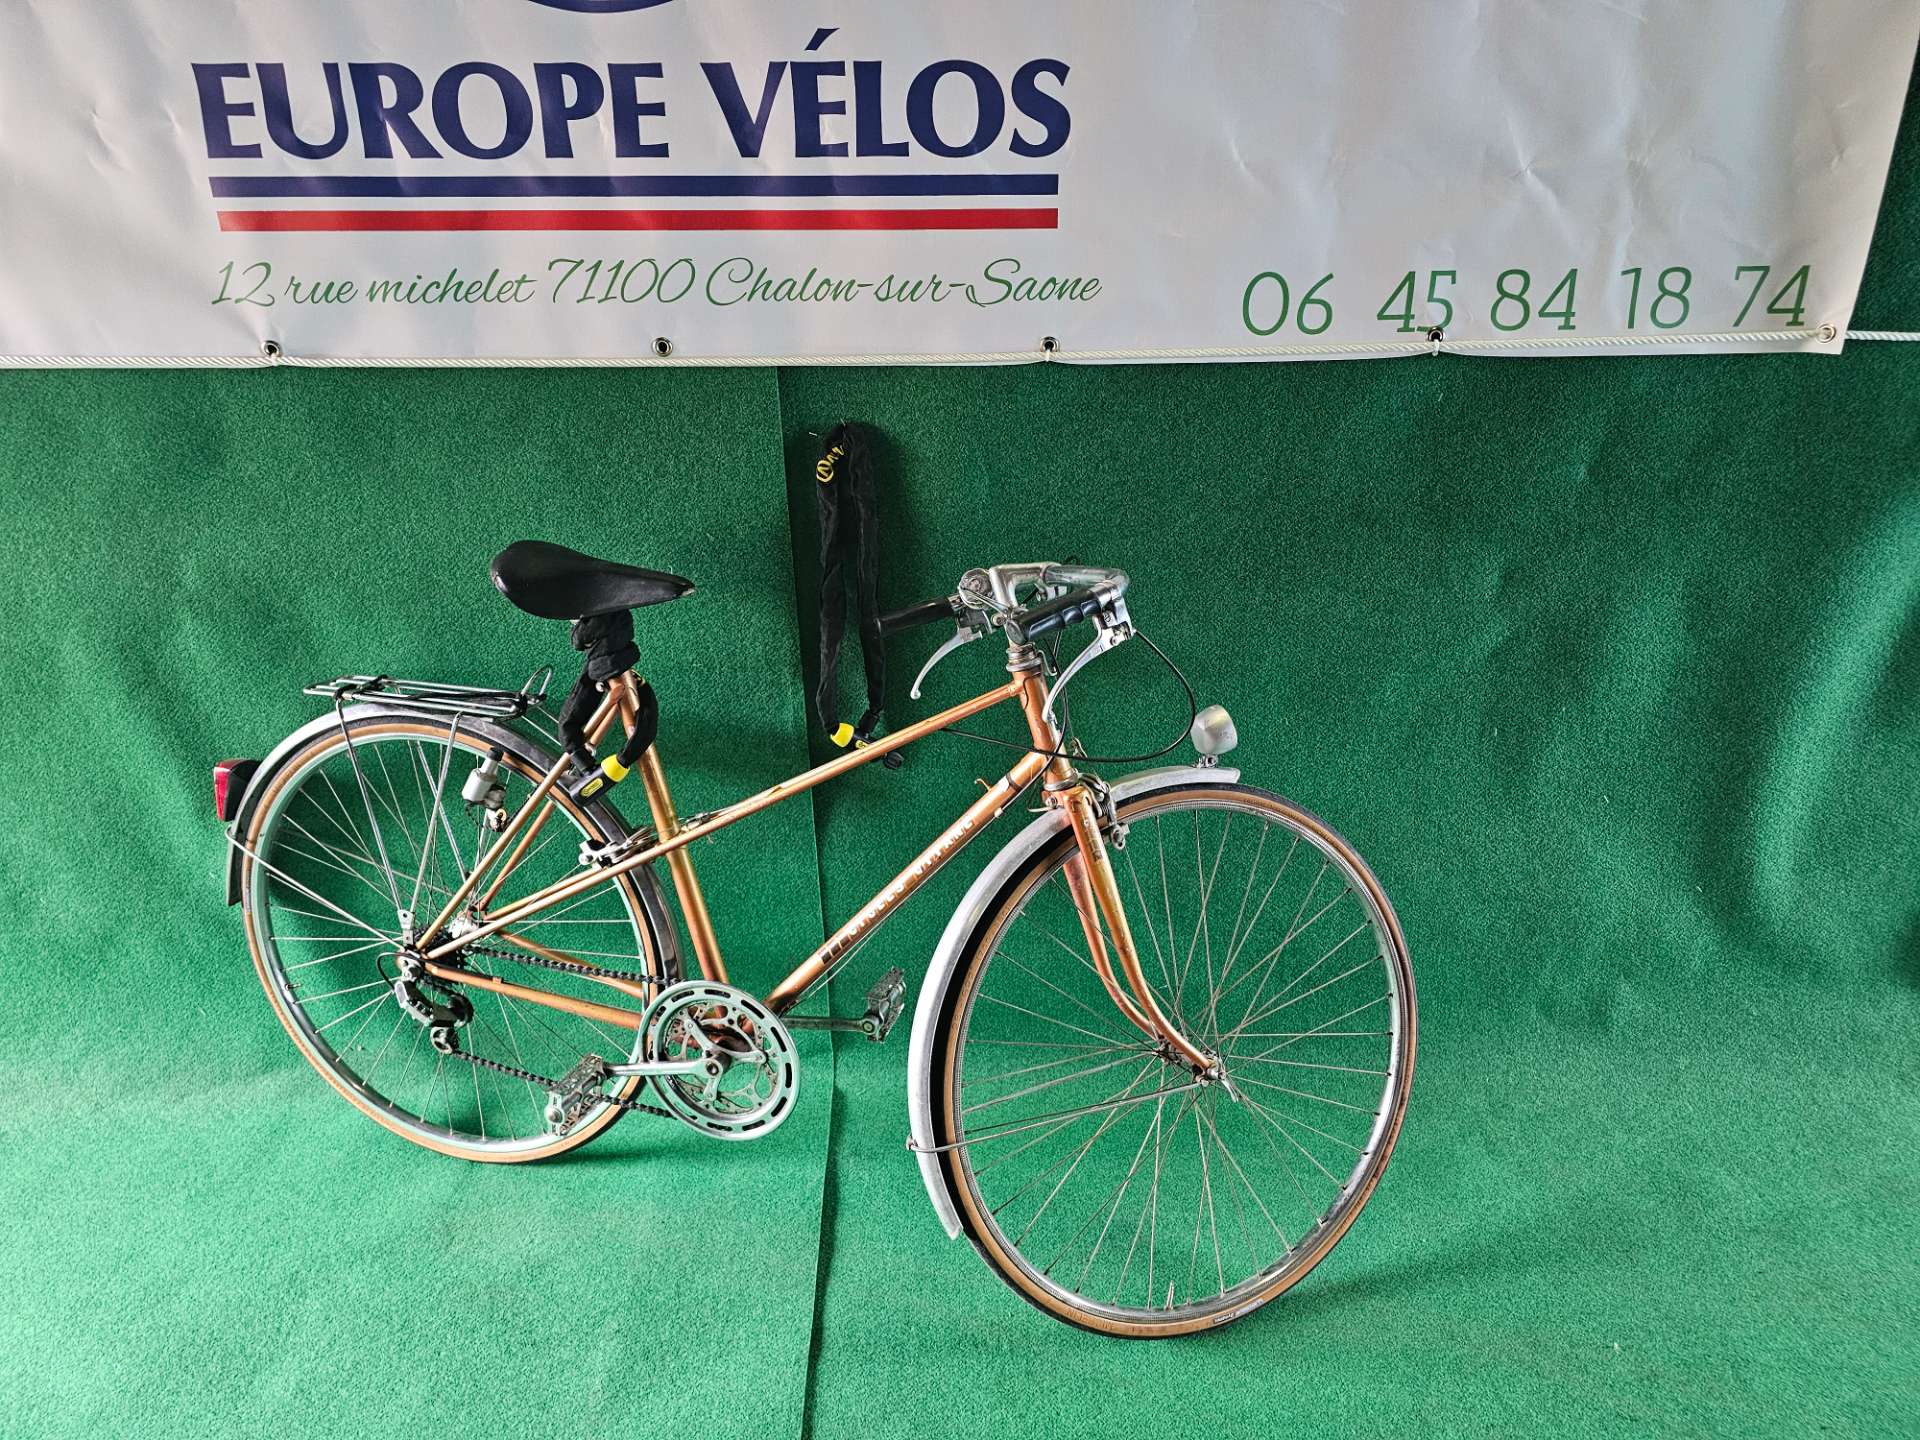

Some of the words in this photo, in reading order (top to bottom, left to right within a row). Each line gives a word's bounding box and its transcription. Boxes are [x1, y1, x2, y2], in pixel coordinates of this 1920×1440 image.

[192, 62, 668, 160] EUROPE
[702, 28, 1071, 158] VÉLOS
[211, 261, 275, 307] 12
[284, 275, 358, 304] rue
[365, 268, 537, 304] michelet
[548, 258, 696, 304] 71100
[706, 257, 1102, 308] Chalon-sur-Saone
[1242, 271, 1336, 337] 06
[1376, 267, 1458, 334] 45
[1490, 265, 1581, 333] 84
[1616, 264, 1693, 330] 18
[1732, 262, 1809, 328] 74
